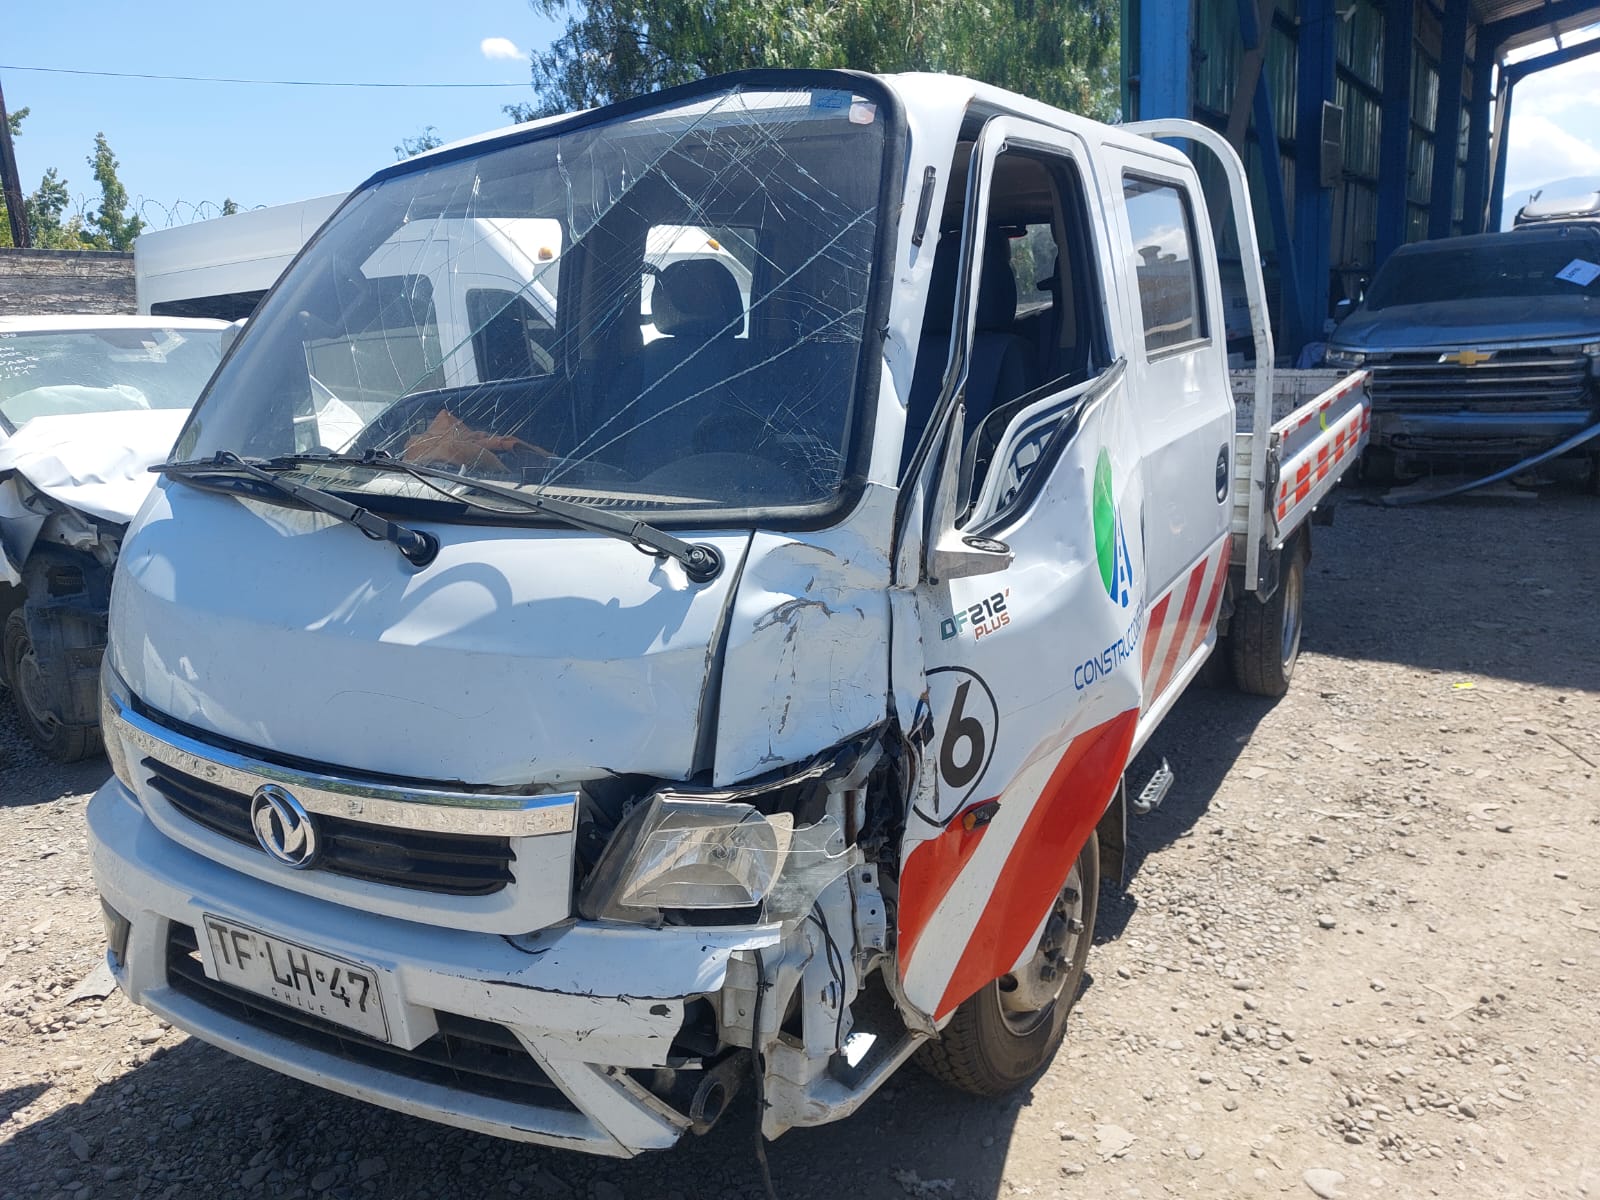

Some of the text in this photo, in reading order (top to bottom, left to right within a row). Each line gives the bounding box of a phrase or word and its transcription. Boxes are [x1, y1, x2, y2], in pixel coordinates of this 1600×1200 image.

[975, 612, 1010, 640] PLUS
[940, 680, 985, 788] 6
[271, 986, 327, 1016] CHILE
